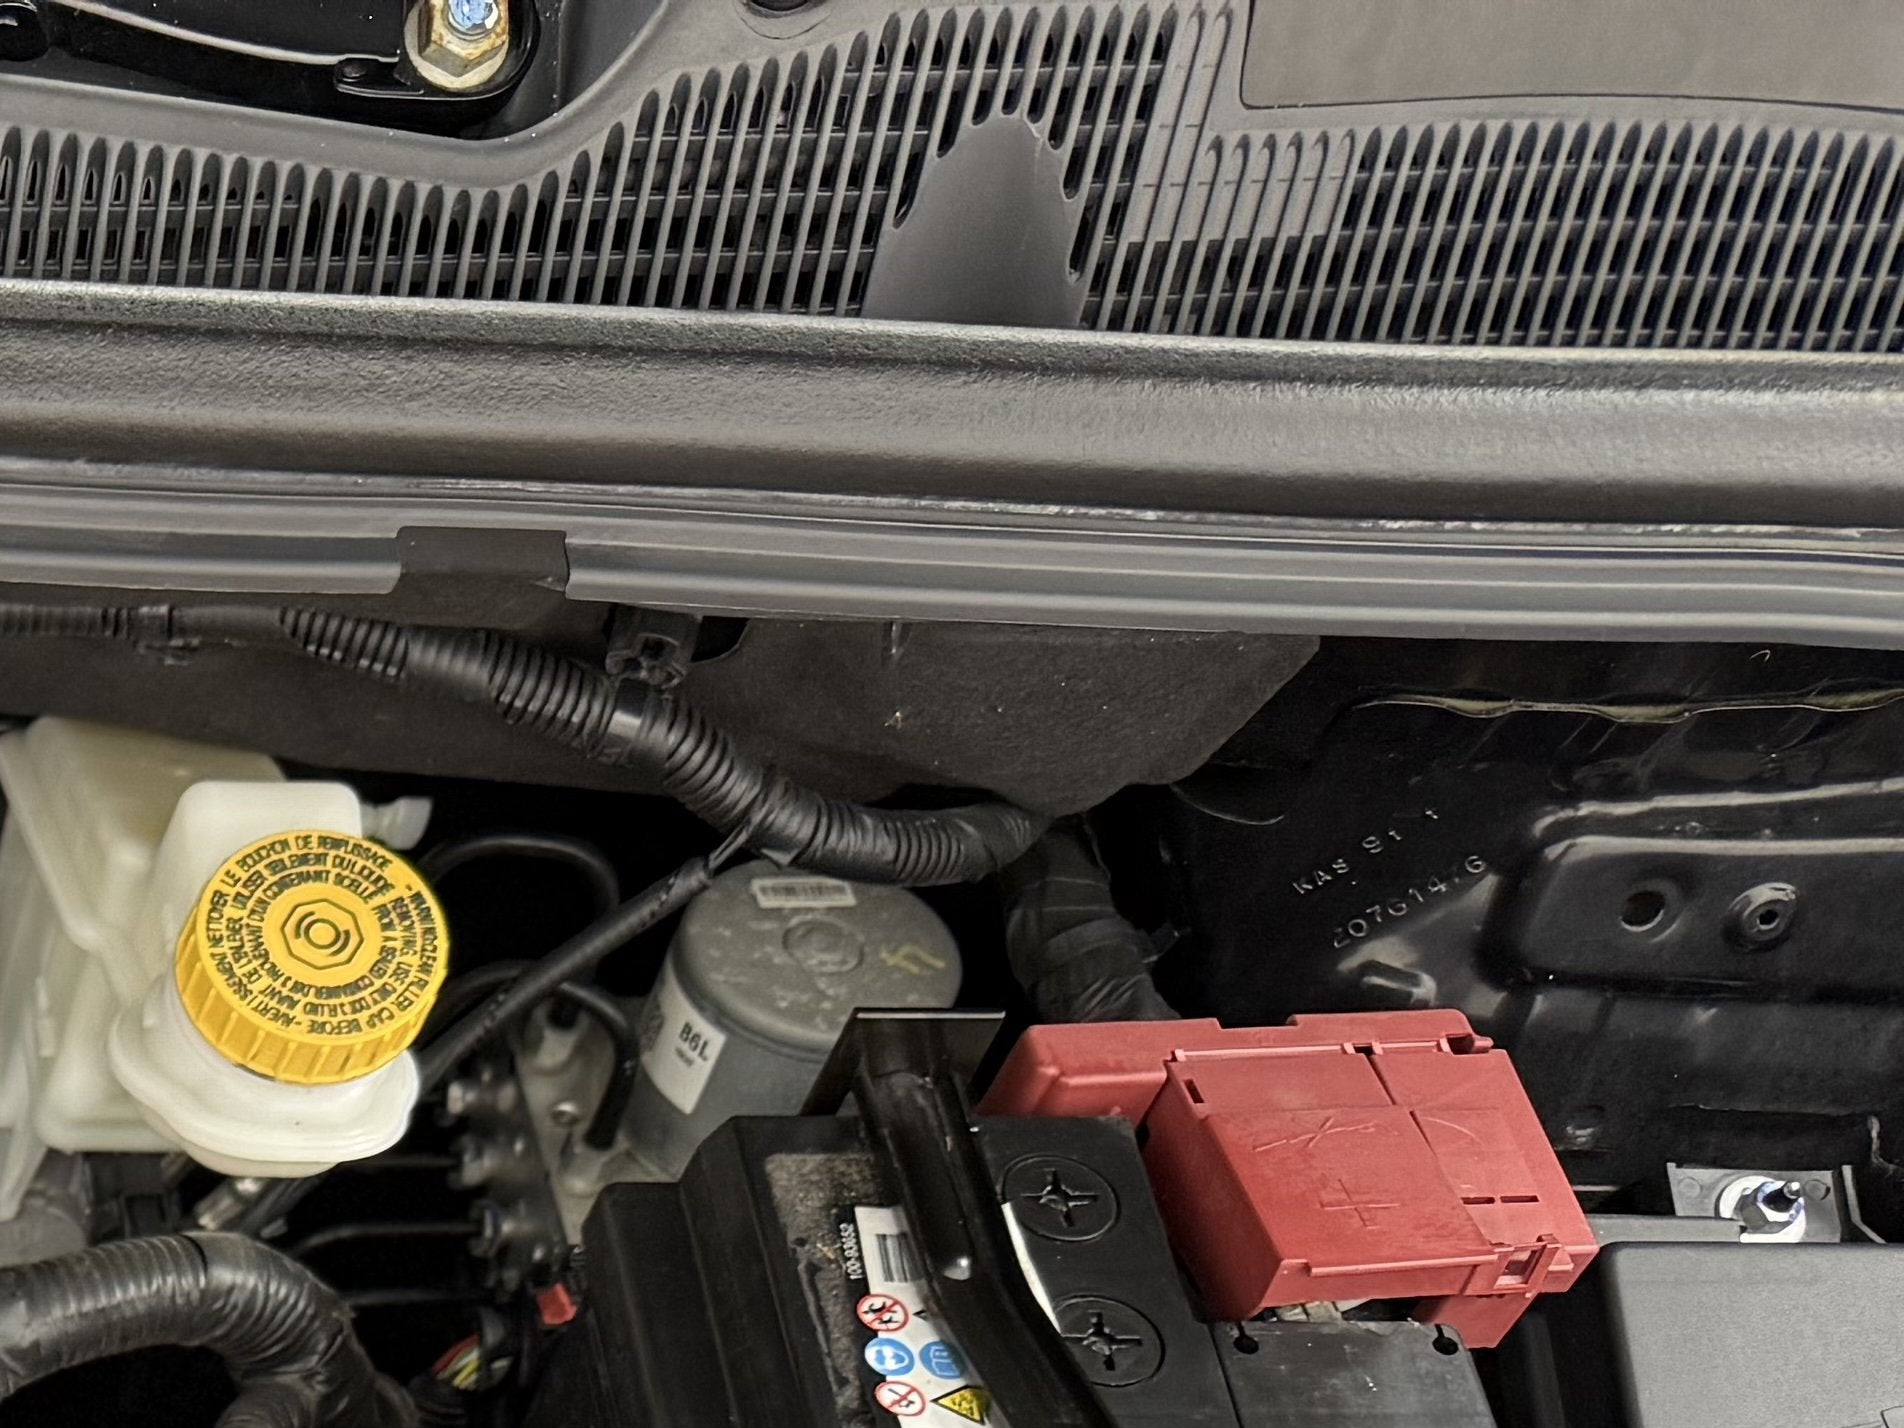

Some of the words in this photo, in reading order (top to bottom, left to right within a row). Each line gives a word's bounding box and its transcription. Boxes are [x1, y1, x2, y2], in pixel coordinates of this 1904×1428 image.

[219, 869, 242, 888] LE
[294, 835, 313, 850] DE
[366, 1007, 395, 1029] CAP
